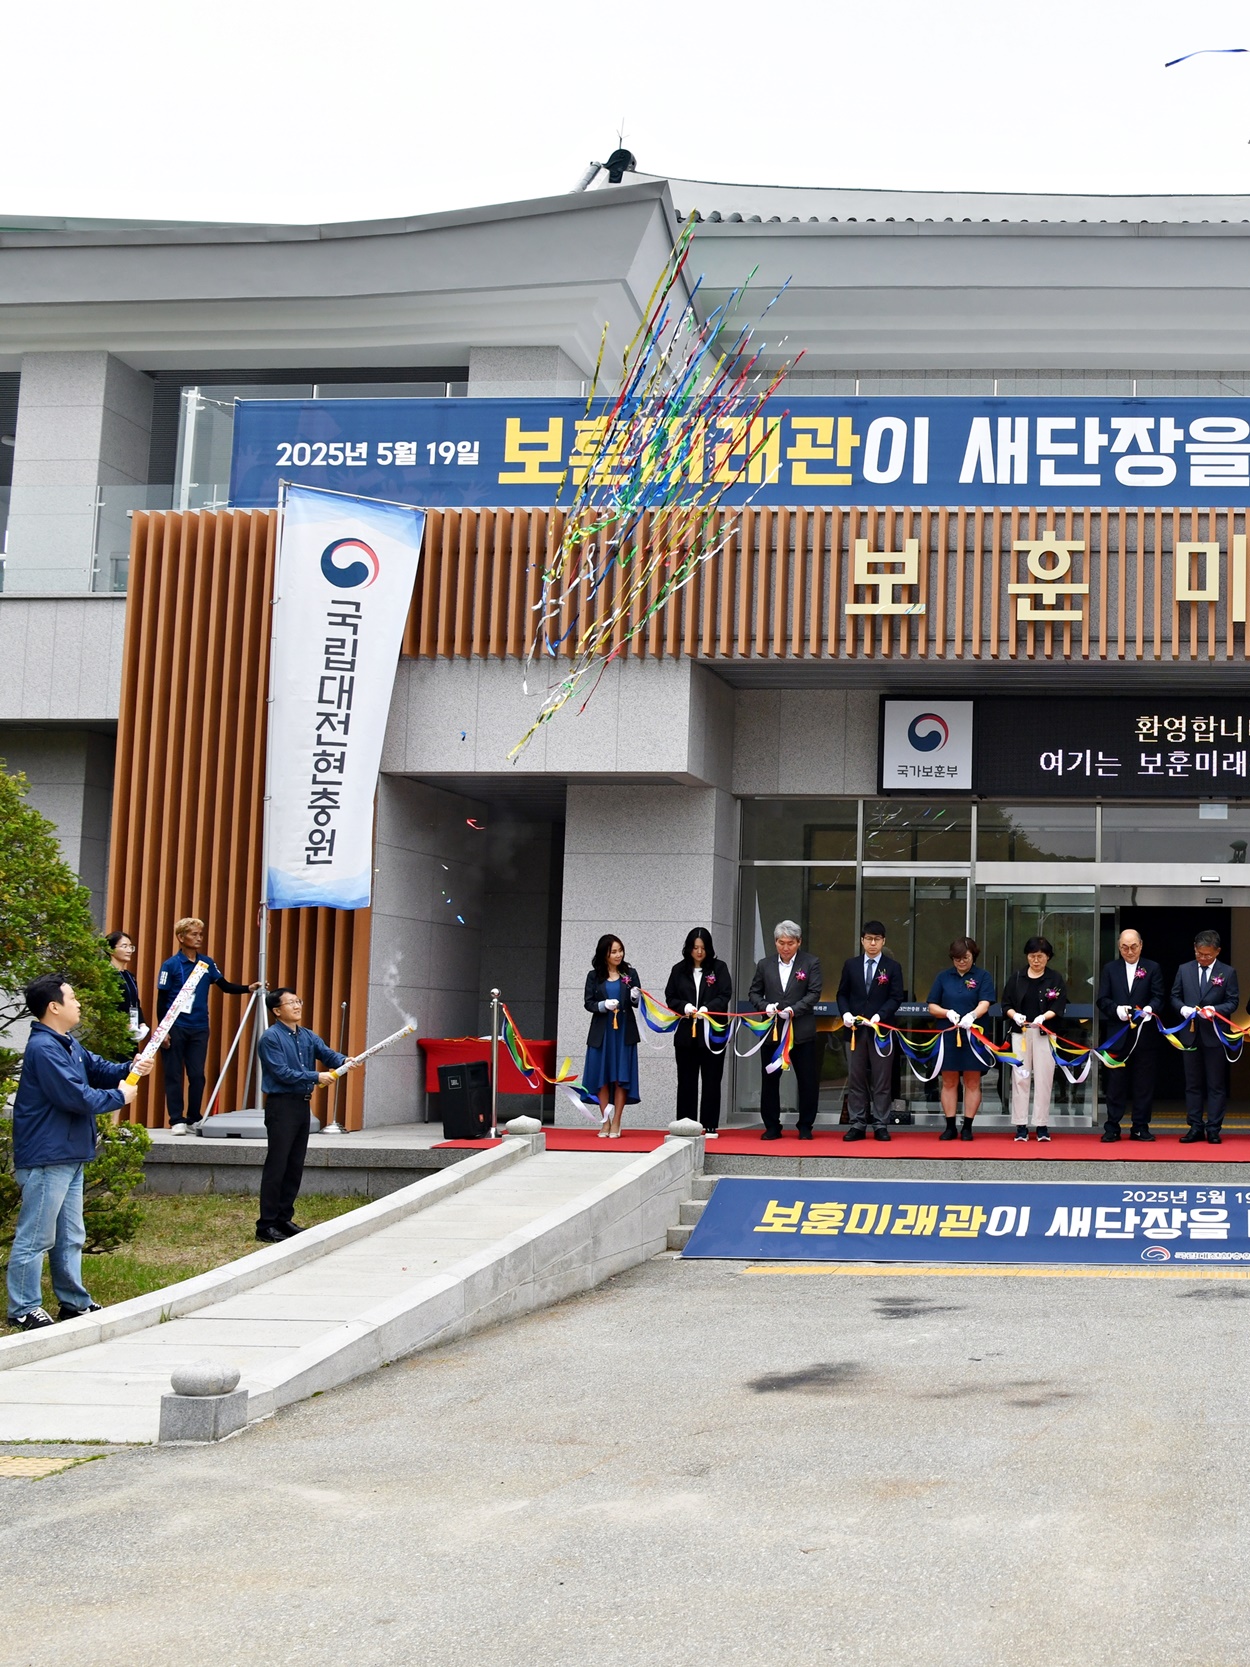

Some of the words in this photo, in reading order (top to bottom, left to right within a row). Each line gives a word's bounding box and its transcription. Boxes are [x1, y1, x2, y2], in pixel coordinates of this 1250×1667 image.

[275, 441, 367, 468] 2025년
[376, 441, 417, 468] 5월
[427, 440, 480, 467] 19일
[304, 600, 362, 865] 국립대전현충원
[896, 764, 959, 778] 국가보훈부
[1039, 749, 1122, 778] 여기는
[1121, 1190, 1188, 1204] 2025년
[1195, 1189, 1226, 1205] 5월
[753, 1199, 1031, 1239] 보훈미래관이
[1045, 1206, 1231, 1240] 새단장을
